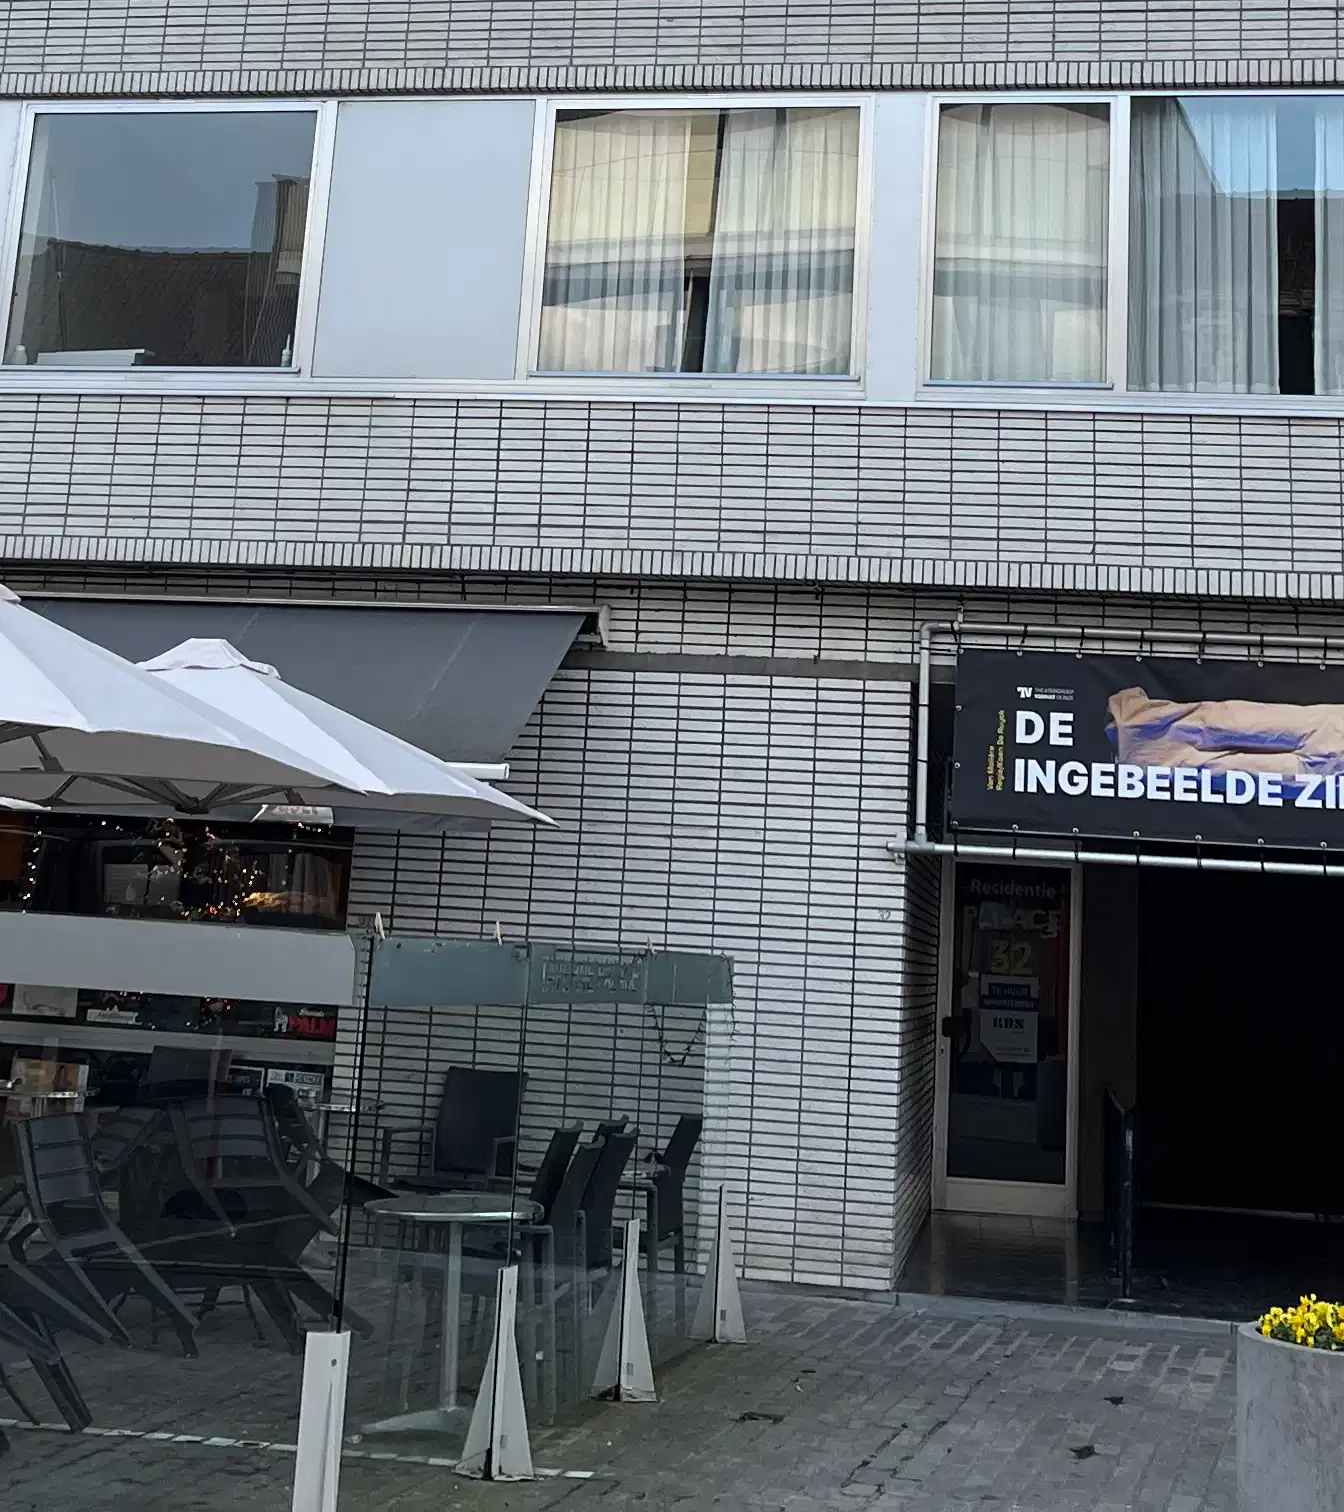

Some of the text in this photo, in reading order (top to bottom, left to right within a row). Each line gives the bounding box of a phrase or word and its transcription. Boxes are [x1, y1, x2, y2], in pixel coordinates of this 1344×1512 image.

[1015, 710, 1074, 747] DE
[1013, 758, 1283, 808] INGEBEELDE
[991, 938, 1033, 975] 32
